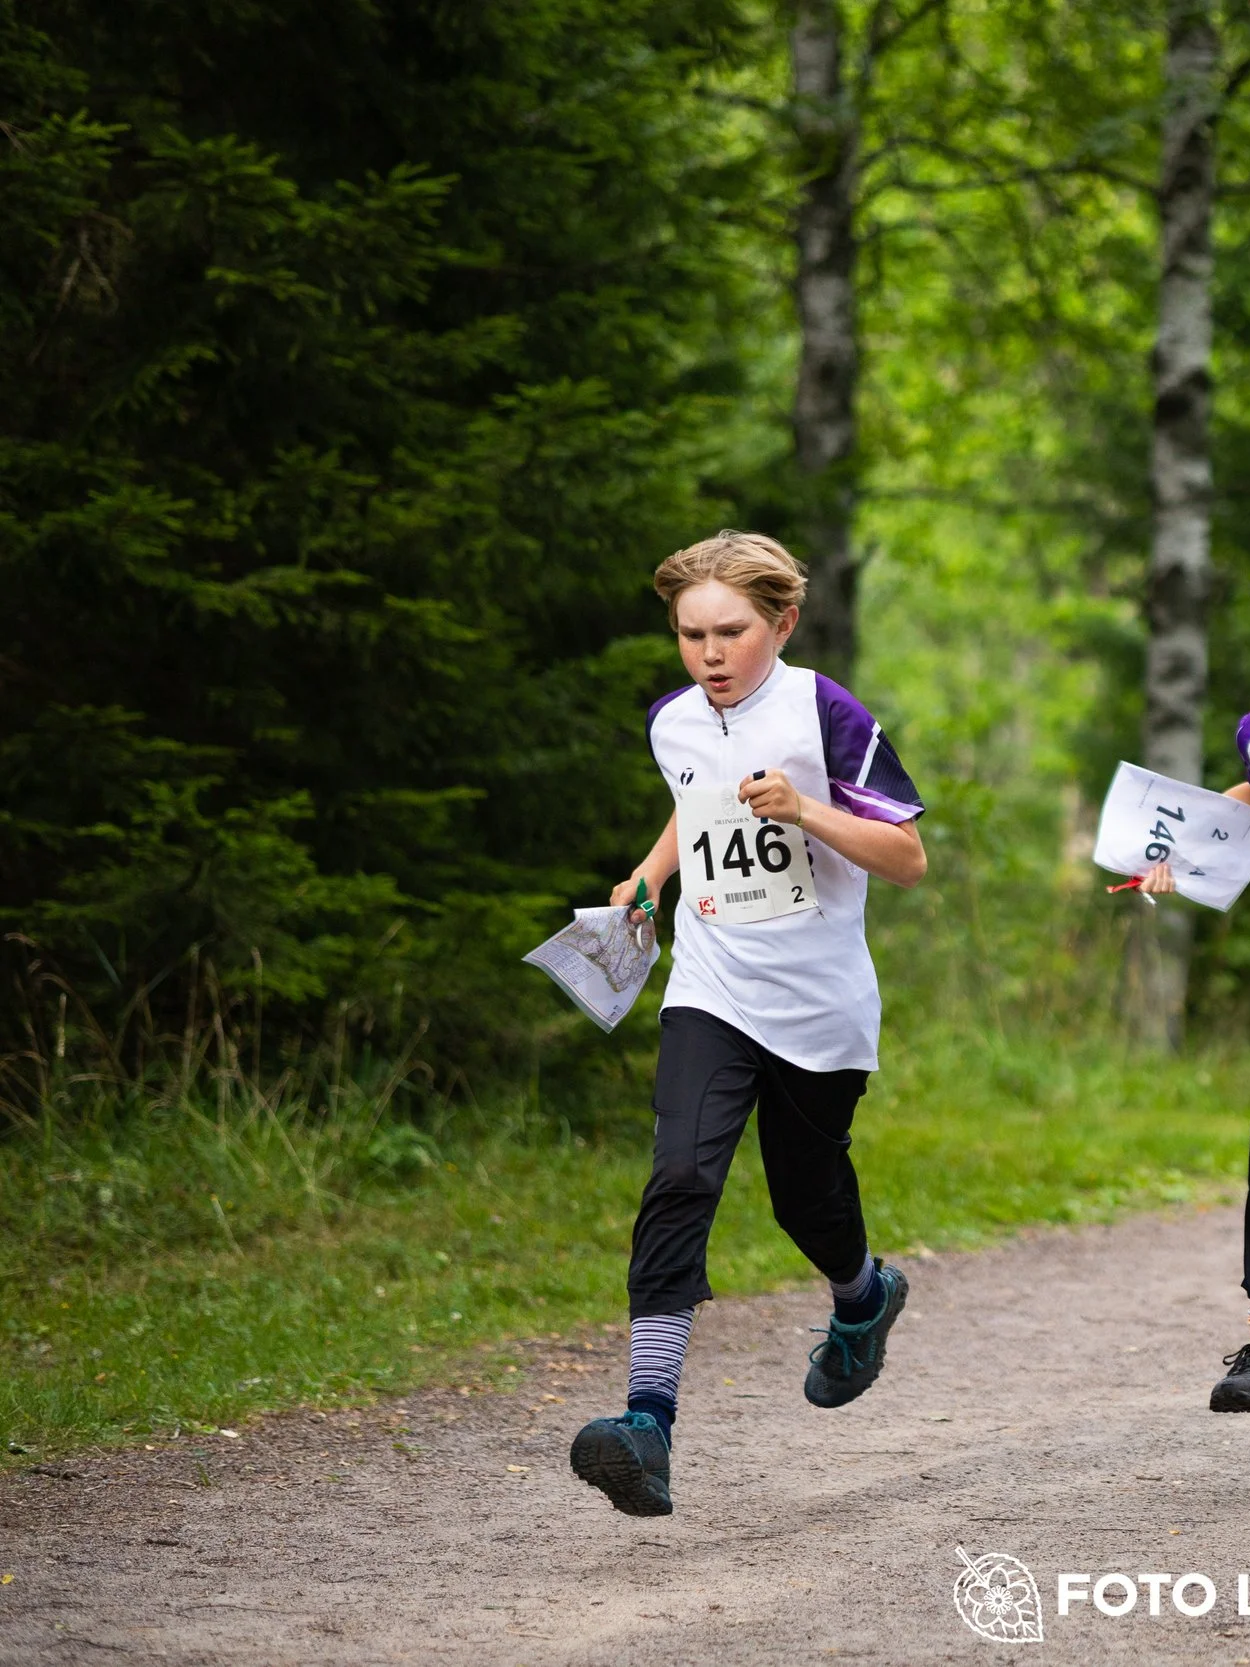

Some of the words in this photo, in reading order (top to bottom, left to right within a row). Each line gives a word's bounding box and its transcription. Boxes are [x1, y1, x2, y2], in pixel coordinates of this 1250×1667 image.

[692, 824, 792, 881] 146
[1145, 805, 1186, 863] 146
[1211, 828, 1229, 841] 2
[791, 886, 805, 903] 2
